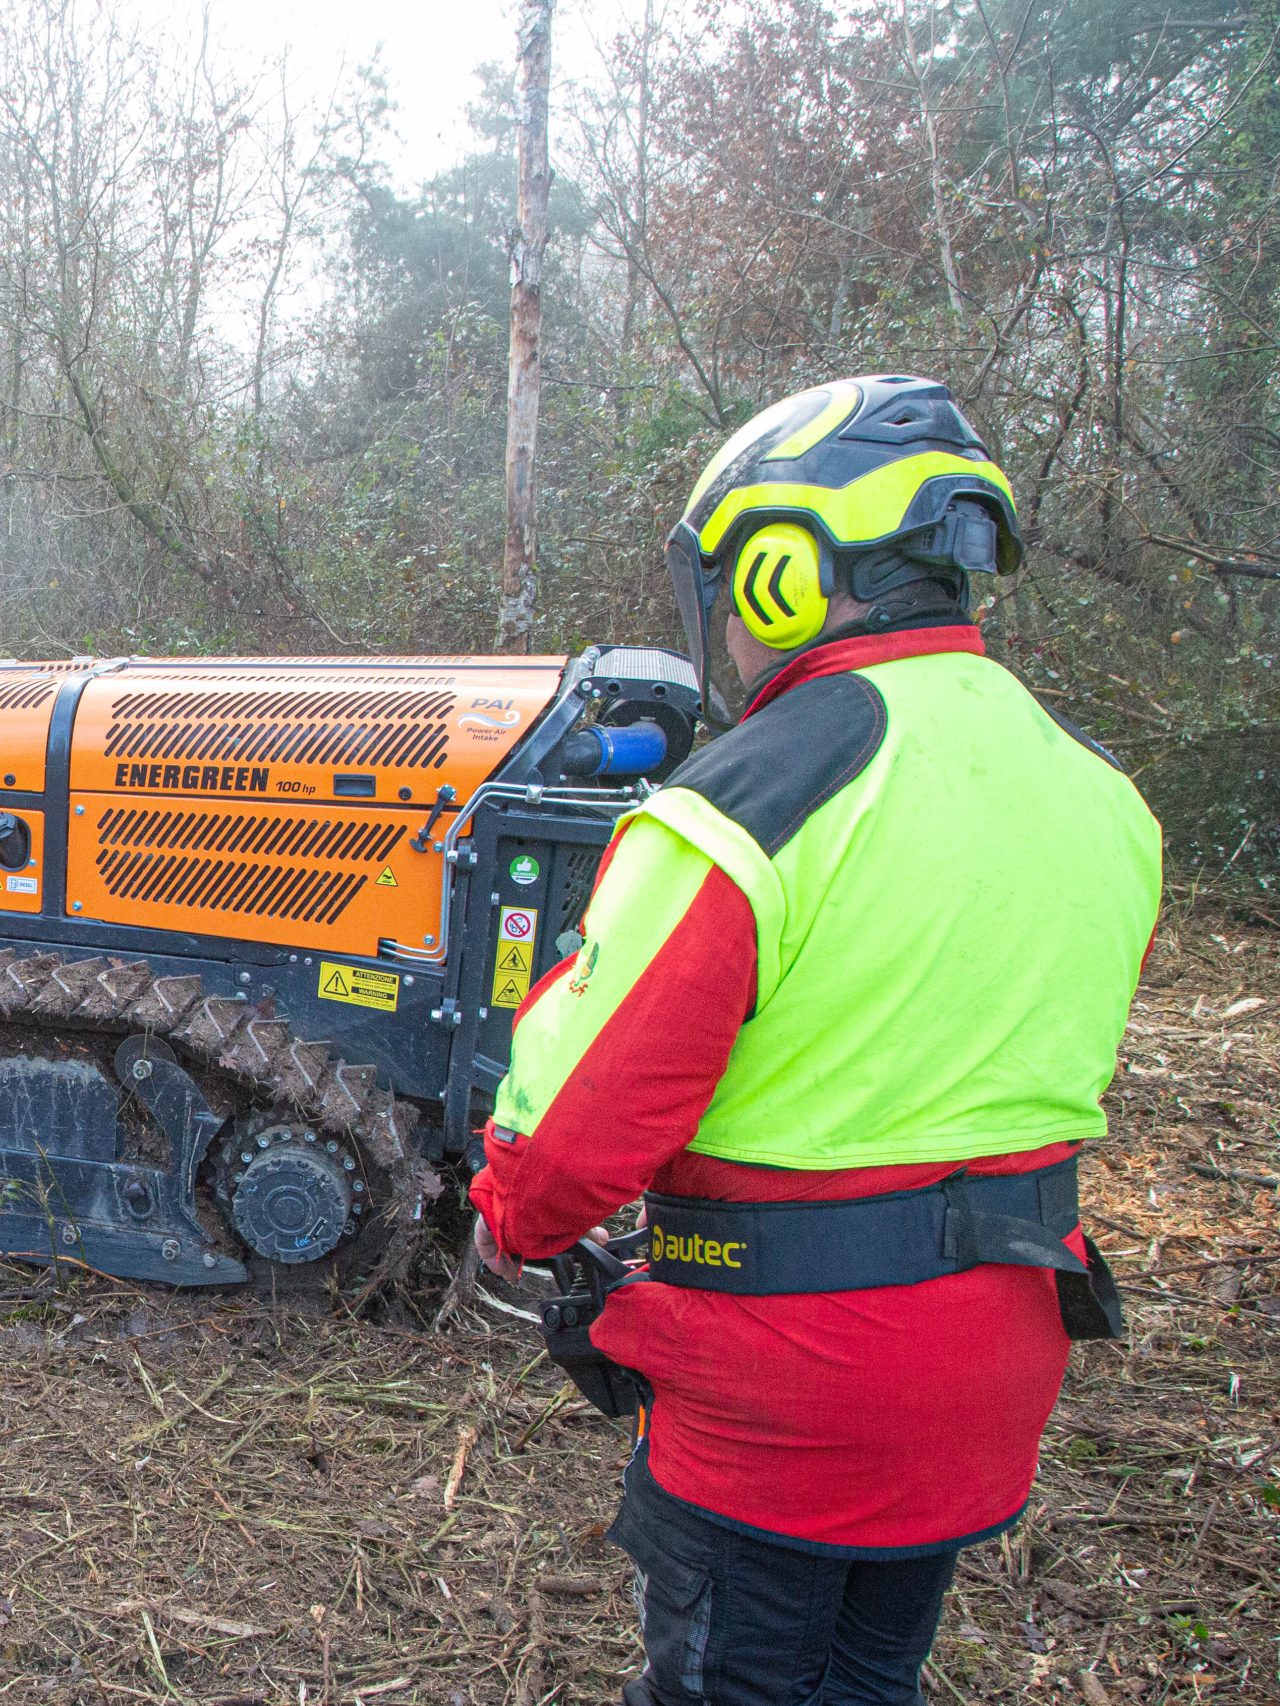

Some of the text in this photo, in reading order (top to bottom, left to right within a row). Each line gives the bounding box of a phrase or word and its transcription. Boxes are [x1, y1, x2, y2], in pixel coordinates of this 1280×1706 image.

[471, 698, 514, 710] PAI
[466, 727, 492, 735] Power
[115, 763, 316, 795] ENERGREEN 100 hp
[355, 971, 394, 984] ATTENZIONE
[358, 988, 388, 999] WARNING
[665, 1234, 741, 1268] autec
